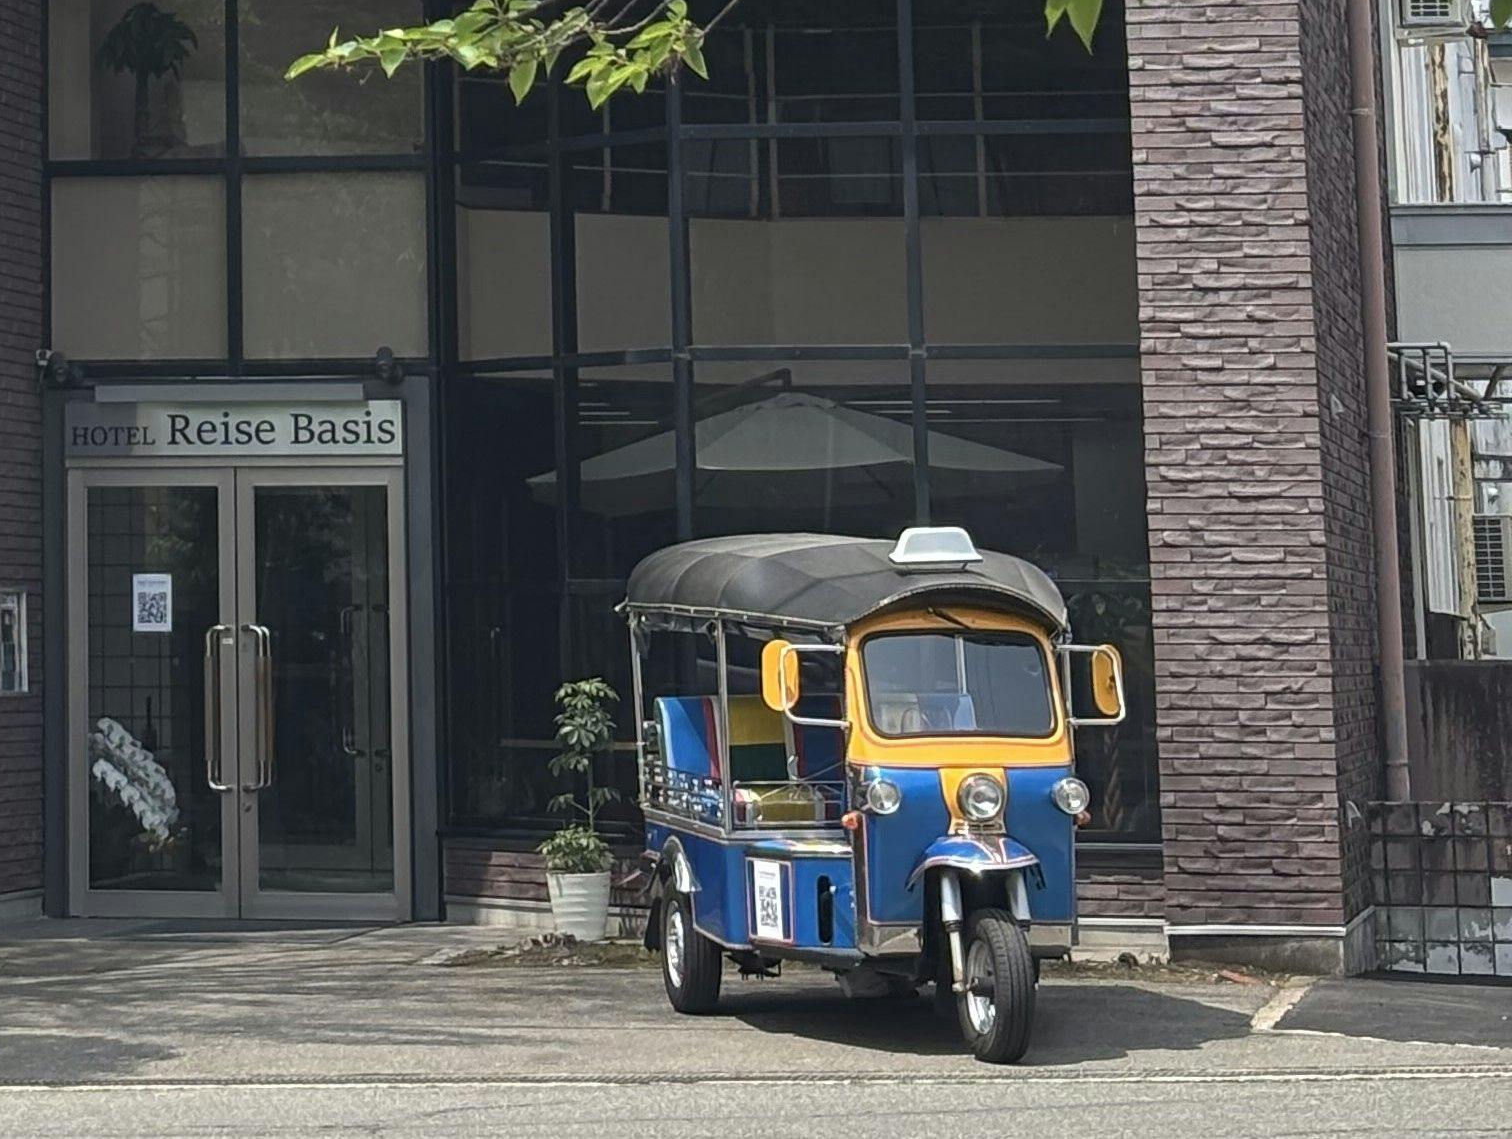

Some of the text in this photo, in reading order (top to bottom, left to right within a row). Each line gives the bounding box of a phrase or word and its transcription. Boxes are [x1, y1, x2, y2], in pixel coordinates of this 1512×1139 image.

[71, 410, 396, 446] HOTEL Reise Basis
